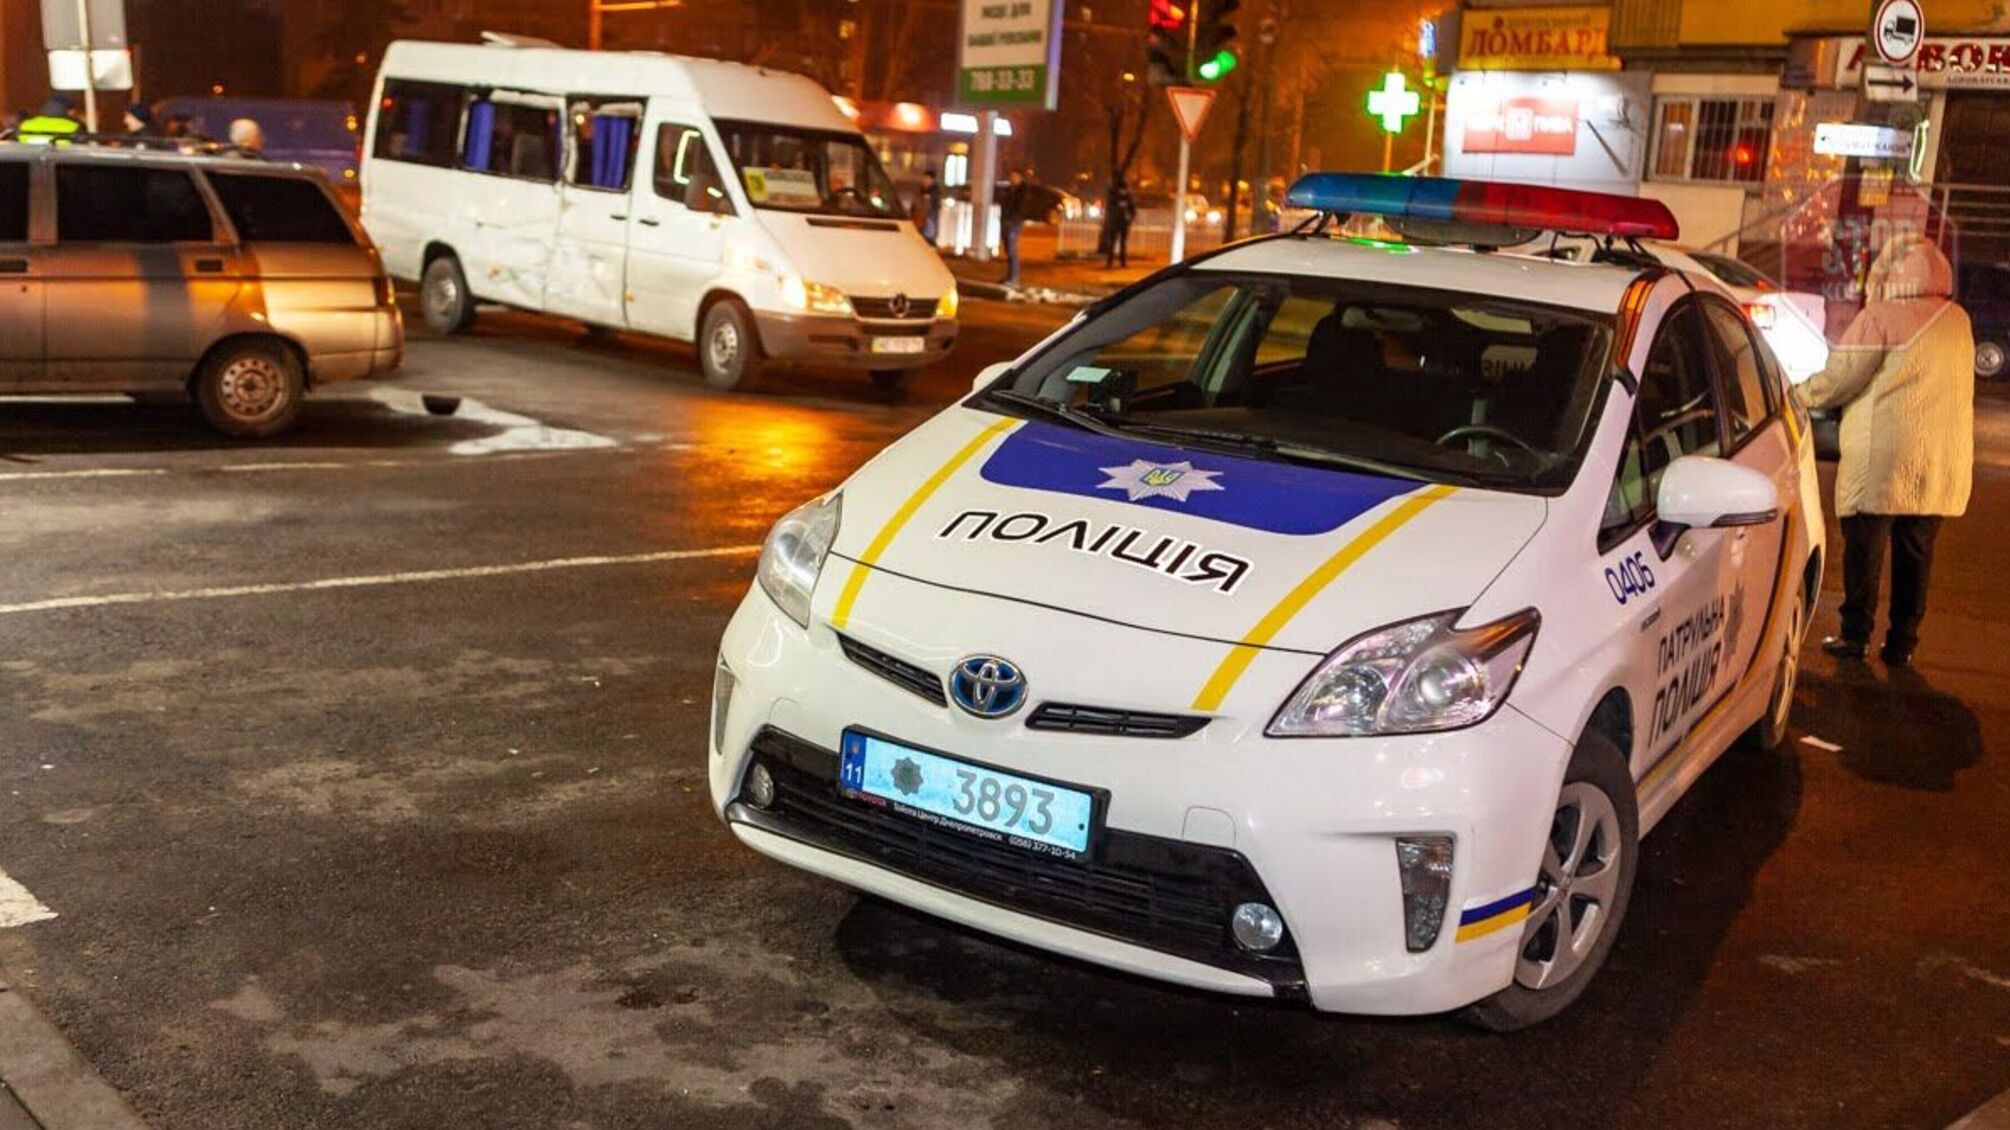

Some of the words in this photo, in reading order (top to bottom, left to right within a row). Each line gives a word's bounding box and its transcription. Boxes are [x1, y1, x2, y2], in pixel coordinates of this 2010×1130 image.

[938, 509, 1251, 593] ПОЛІЦІЯ
[1604, 550, 1655, 605] 0406
[1657, 594, 1724, 678] ПАТРУЛЬНА
[1647, 640, 1721, 748] ПОЛІЦІЯ
[845, 763, 862, 784] 11
[953, 768, 1055, 834] 3893
